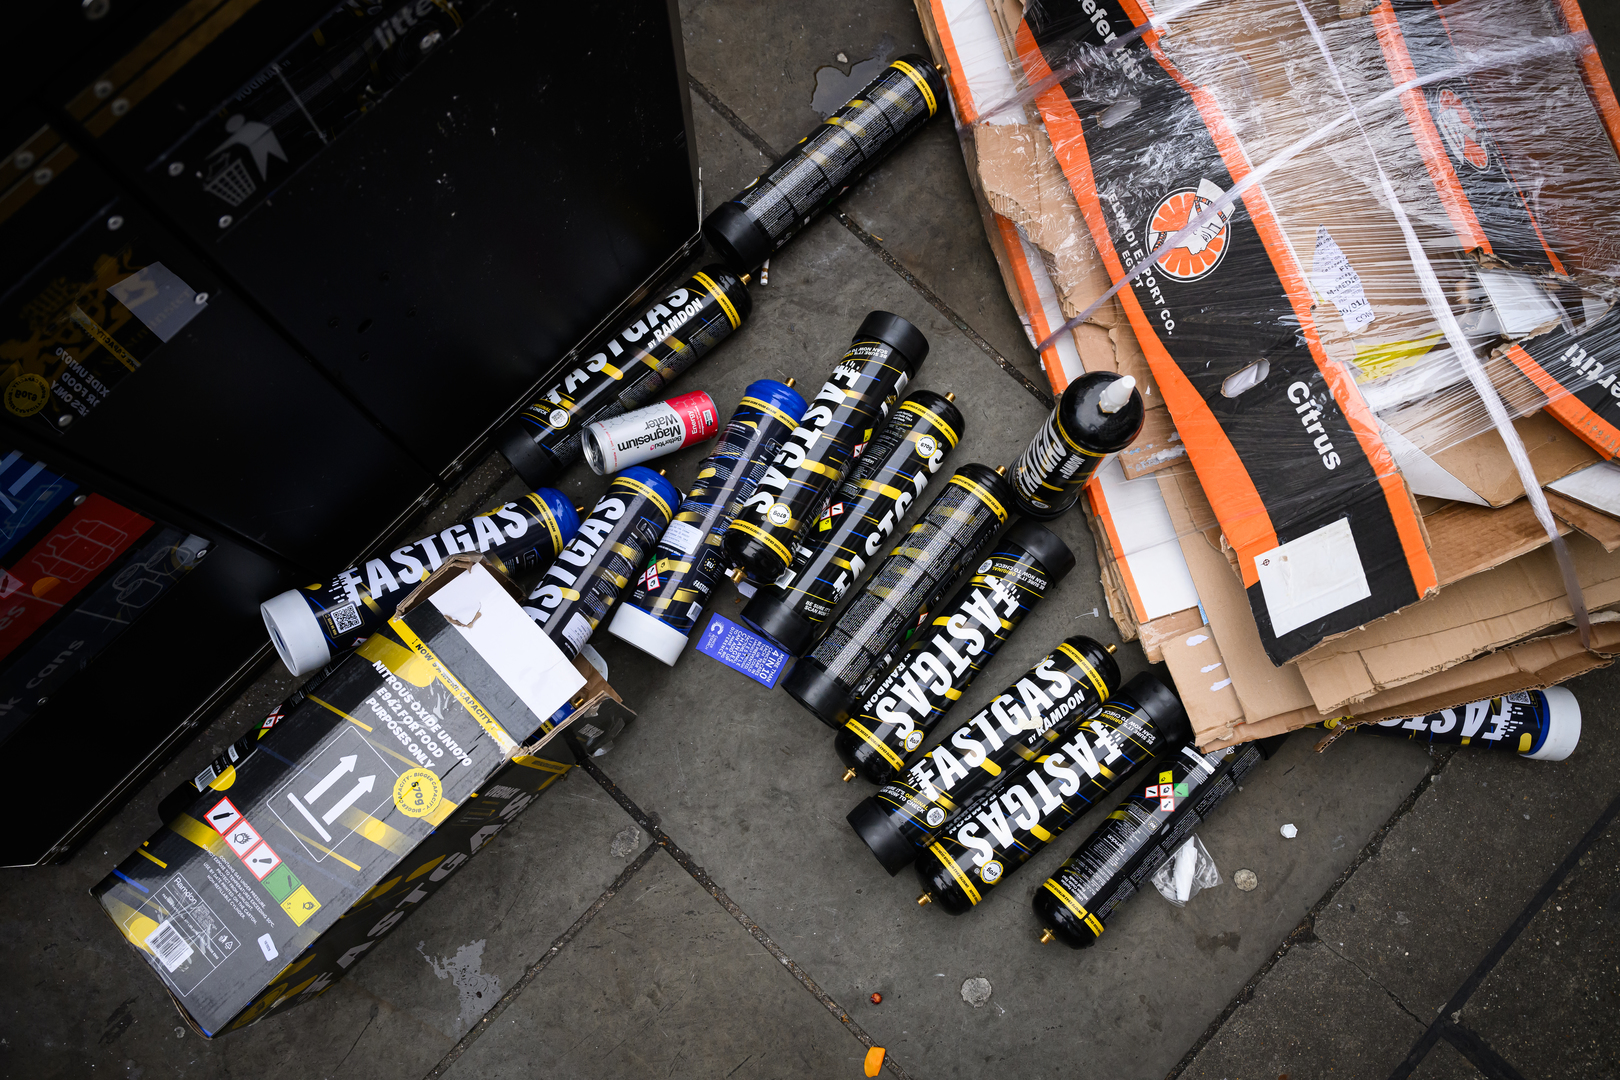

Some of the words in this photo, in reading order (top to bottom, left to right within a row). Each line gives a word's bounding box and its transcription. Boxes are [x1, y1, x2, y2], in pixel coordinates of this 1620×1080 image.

[370, 0, 436, 51] litte
[651, 296, 706, 343] RAMDON
[645, 337, 658, 349] BY
[641, 412, 678, 433] Water
[684, 408, 700, 435] Energy
[1287, 379, 1342, 471] Citrus
[615, 421, 682, 454] Magnesium
[653, 435, 682, 449] BetterYou
[742, 359, 861, 518] FASTGAS
[332, 497, 532, 609] FASTGAS
[518, 493, 629, 626] ASTGAS
[1013, 566, 1022, 574] TO
[1022, 570, 1035, 580] NOW
[1034, 577, 1047, 586] SCAN
[715, 625, 735, 656] DIFFERENCE.
[734, 630, 743, 641] CAN
[727, 641, 736, 652] ADD
[727, 631, 747, 663] CHANGES
[735, 636, 755, 666] LIFESTYLE
[760, 644, 769, 657] EACH
[760, 646, 773, 664] CANCER
[770, 648, 780, 657] 4
[21, 635, 88, 692] cans
[723, 652, 730, 660] UP
[753, 656, 762, 668] YEAR
[764, 656, 776, 668] IN
[772, 652, 785, 669] MORE
[869, 572, 1021, 743] FASTGAS
[902, 652, 912, 663] BY
[754, 662, 764, 676] CASES
[758, 667, 770, 680] 10
[765, 667, 776, 683] THAN
[414, 642, 434, 663] NOW
[458, 689, 492, 727] CAPACITY
[861, 658, 906, 714] RAMDON
[371, 658, 415, 705] NITROUS
[409, 699, 442, 734] OXIDE
[435, 728, 473, 769] UN1070
[375, 685, 404, 715] E942
[396, 708, 420, 733] FOR
[414, 727, 445, 760] FOOD
[1103, 709, 1120, 719] CHECK
[1120, 715, 1128, 723] TO
[364, 695, 412, 747] PURPOSES
[406, 741, 435, 772] ONLY
[906, 654, 1077, 803] FASTGAS
[1121, 721, 1134, 732] IT'S
[1128, 719, 1143, 731] NOW
[1132, 727, 1147, 741] SURE
[1026, 732, 1039, 745] BY
[1141, 729, 1156, 741] SCAN
[1146, 737, 1154, 745] BE
[410, 781, 424, 806] 670g
[953, 715, 1123, 869] FASTGAS
[897, 793, 907, 803] TO
[905, 798, 925, 814] CHECK
[904, 792, 929, 811] ORIGINAL
[172, 876, 199, 905] Ramdon
[300, 790, 534, 992] FASTGAS
